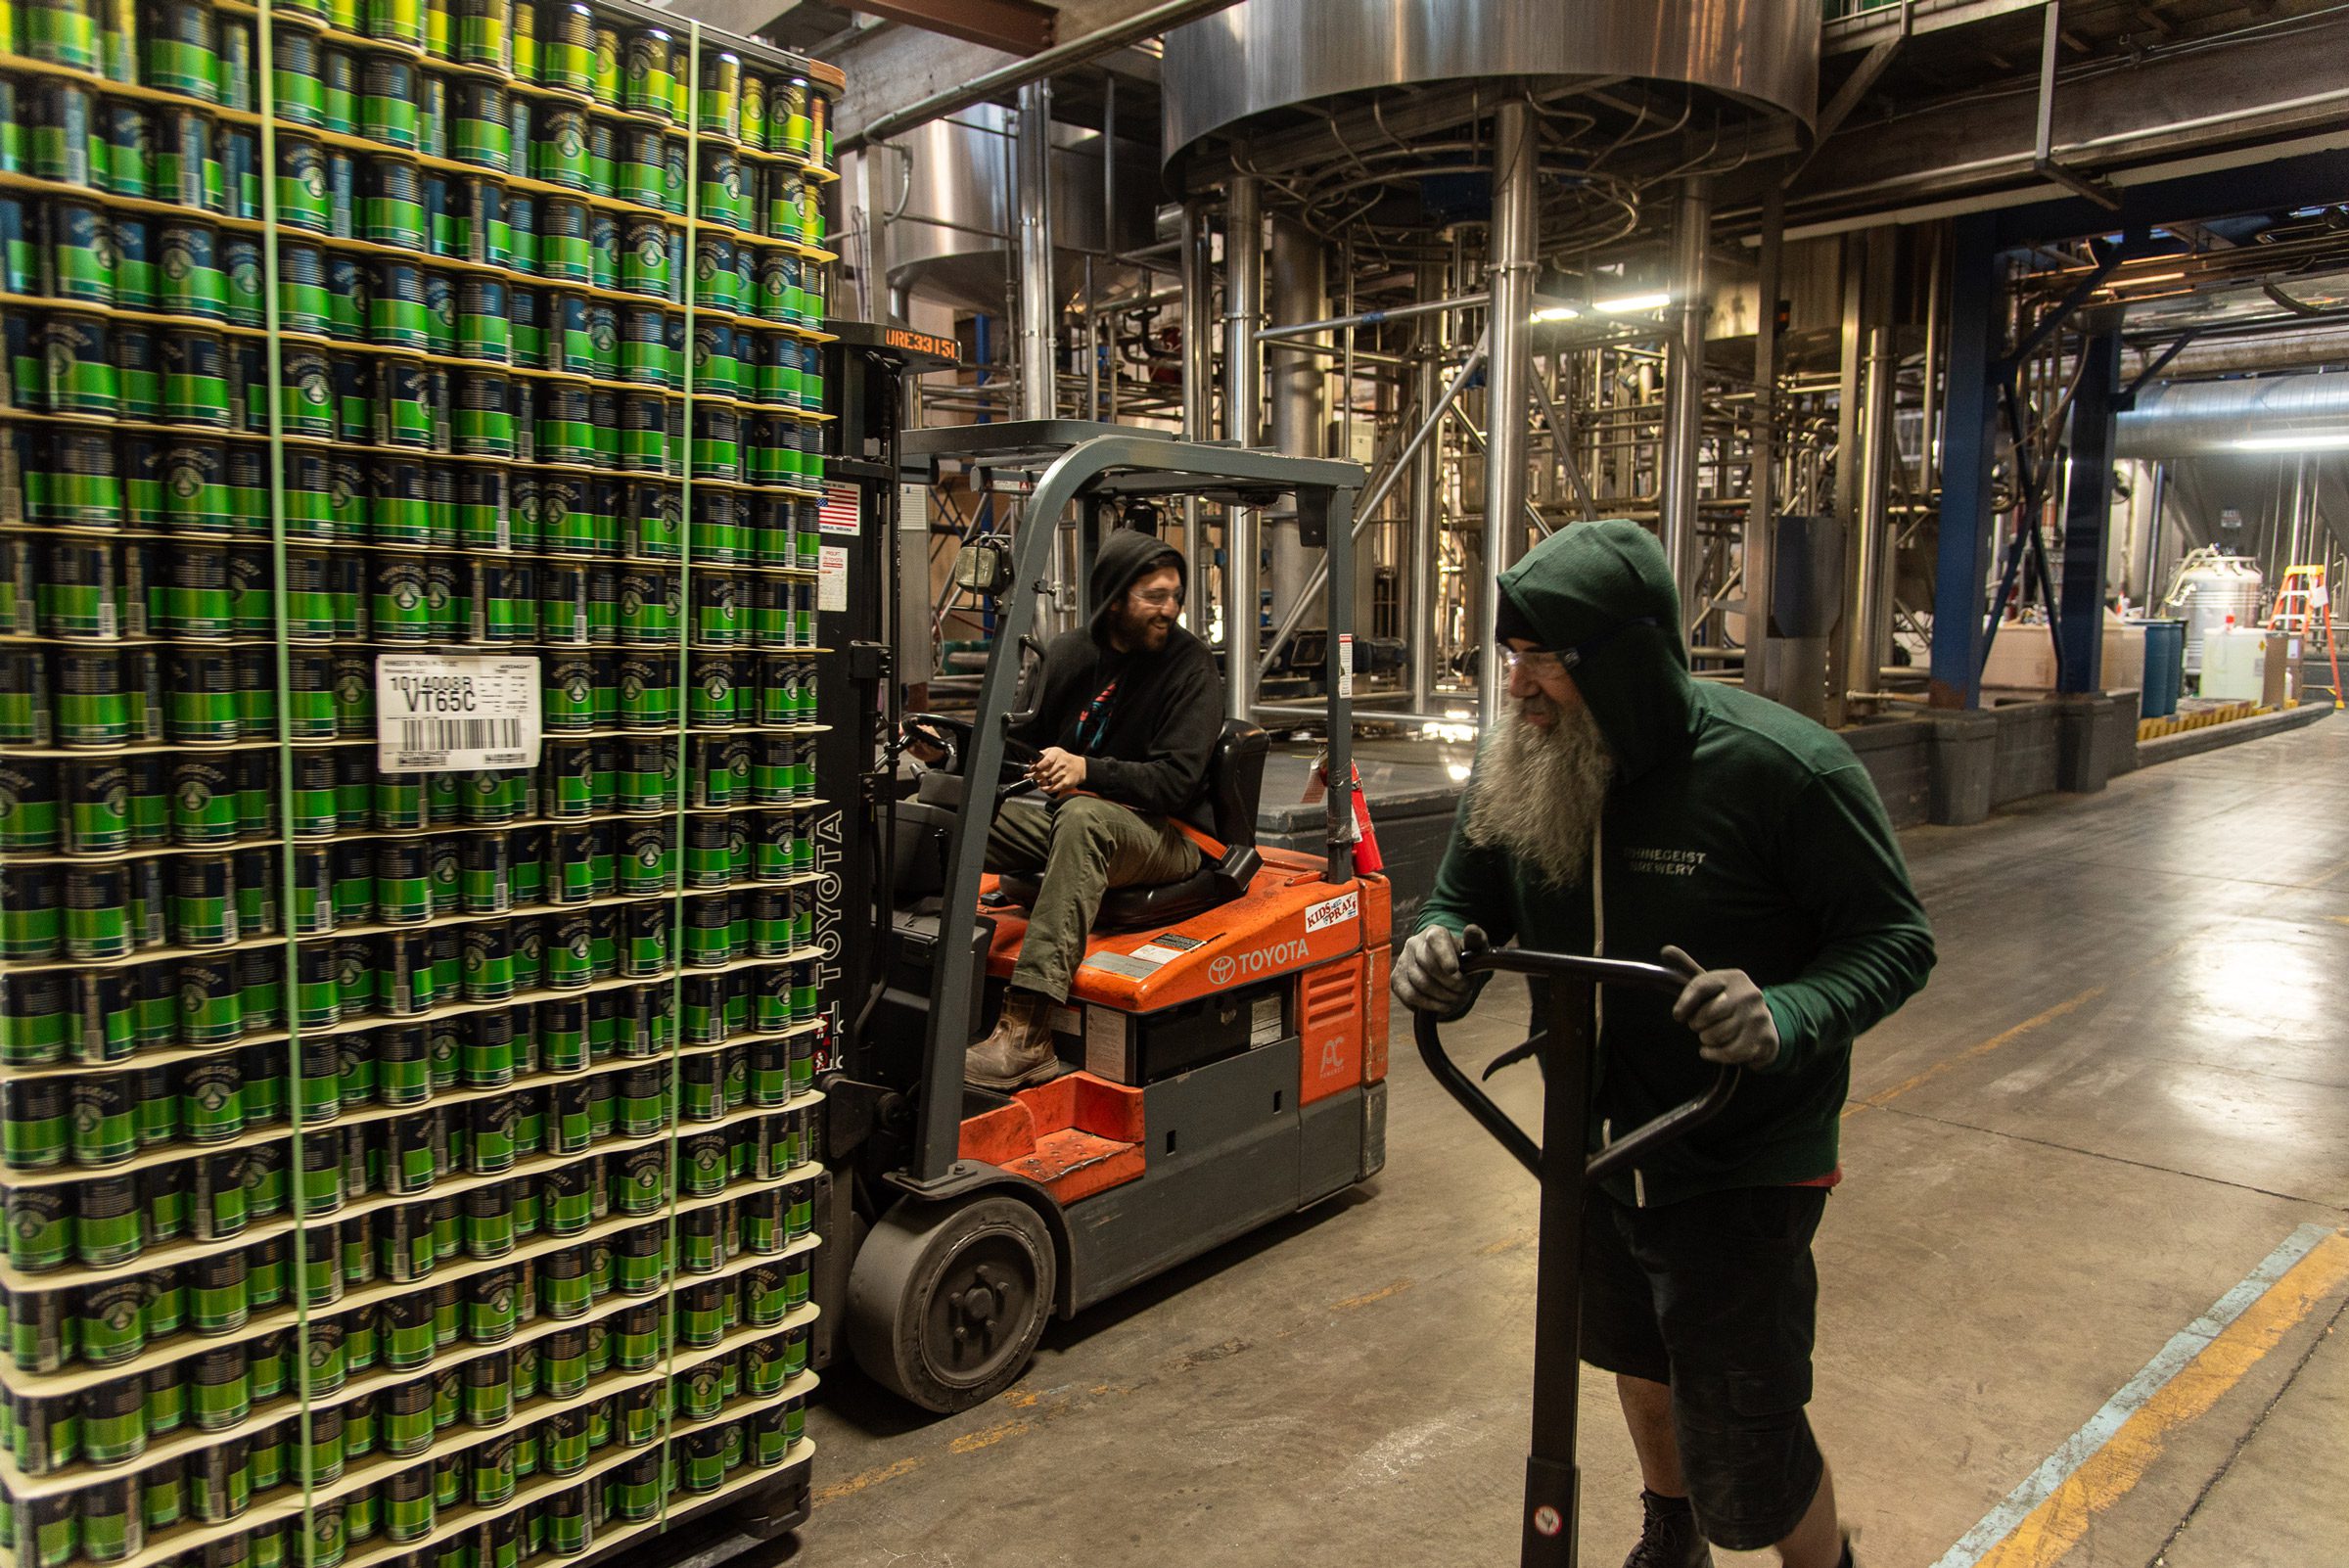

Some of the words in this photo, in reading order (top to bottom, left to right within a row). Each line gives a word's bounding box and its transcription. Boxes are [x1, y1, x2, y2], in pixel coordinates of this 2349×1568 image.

[404, 690, 477, 713] VT65C
[815, 809, 843, 991] TOYOTA
[1307, 902, 1331, 928] KIDS
[1238, 938, 1310, 975] TOYOTA
